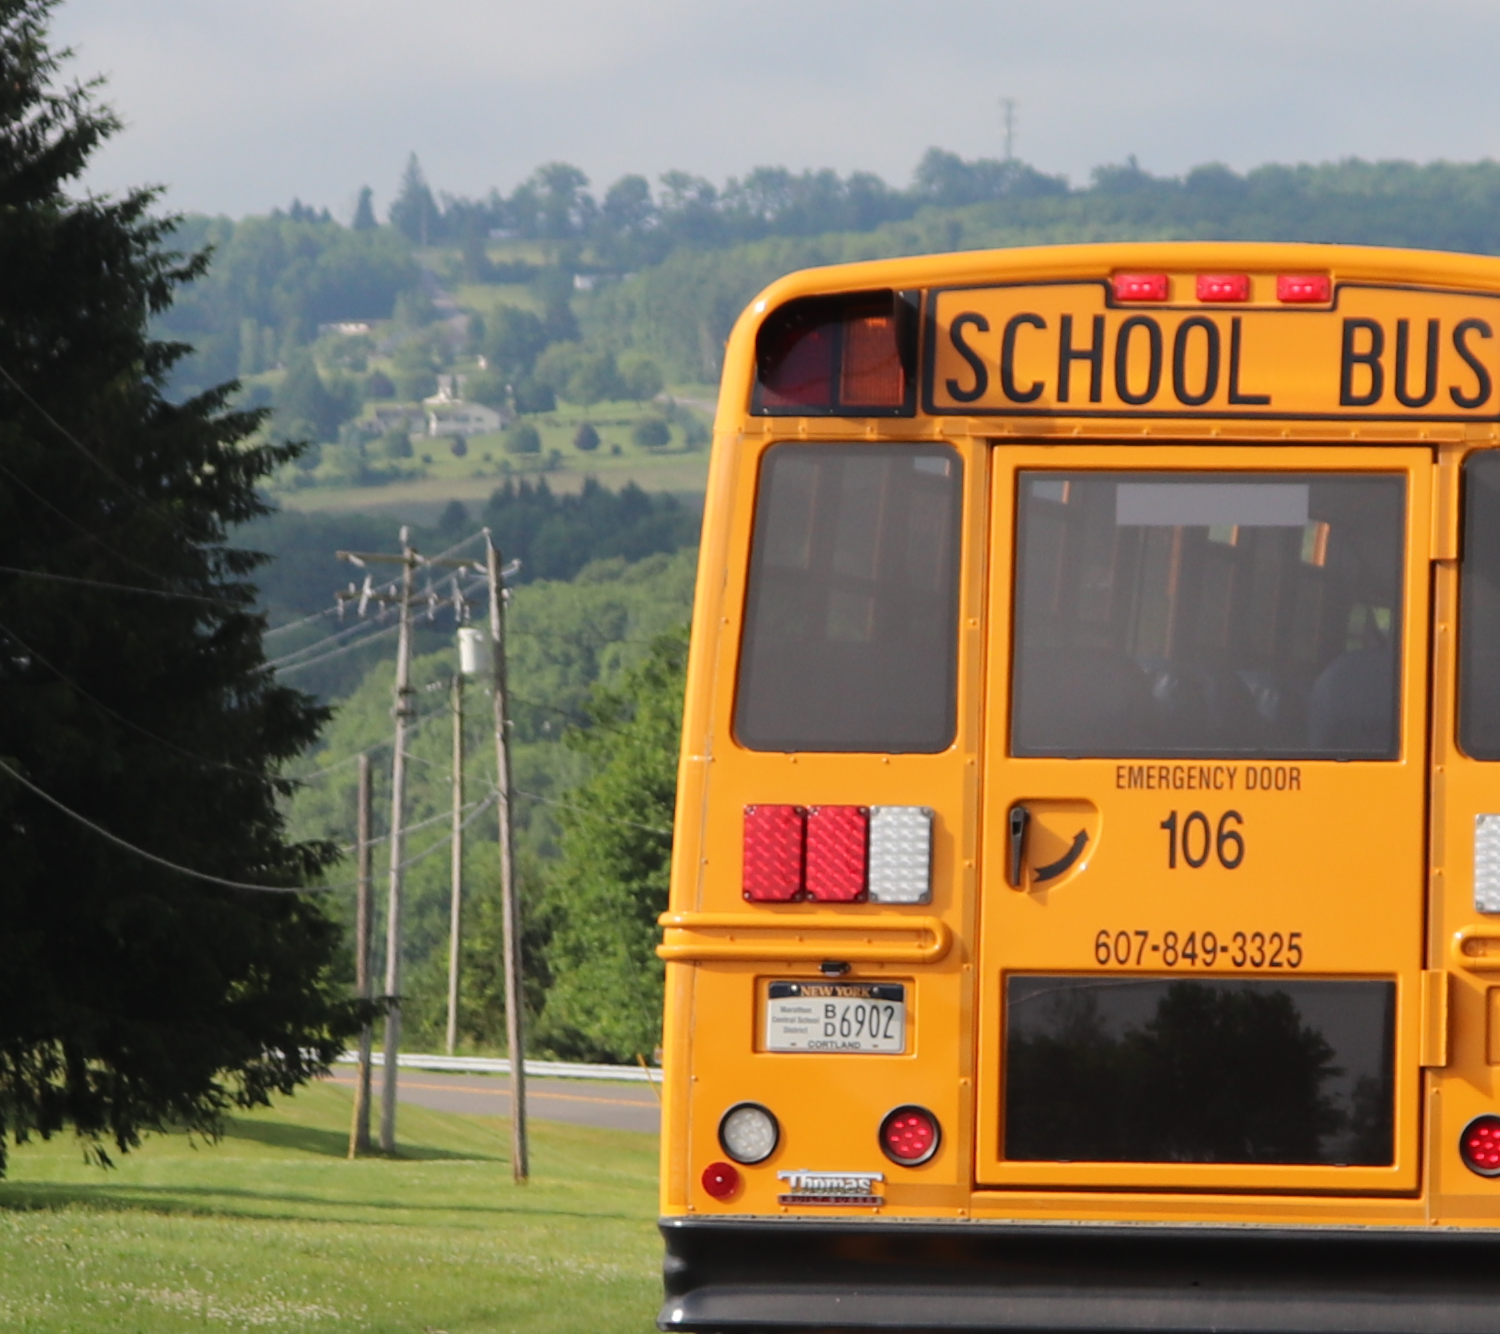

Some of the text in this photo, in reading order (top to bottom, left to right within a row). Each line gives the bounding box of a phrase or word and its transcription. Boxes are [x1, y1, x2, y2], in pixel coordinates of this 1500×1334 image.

[945, 311, 1494, 409] SCHOOL BUS
[1116, 765, 1302, 791] EMERGENCY DOOR
[1160, 810, 1245, 870] 106
[1094, 929, 1303, 968] 607-849-3325
[801, 986, 871, 997] NEW YORK
[808, 1040, 861, 1050] CORTLAND
[777, 1169, 884, 1195] Thomas
